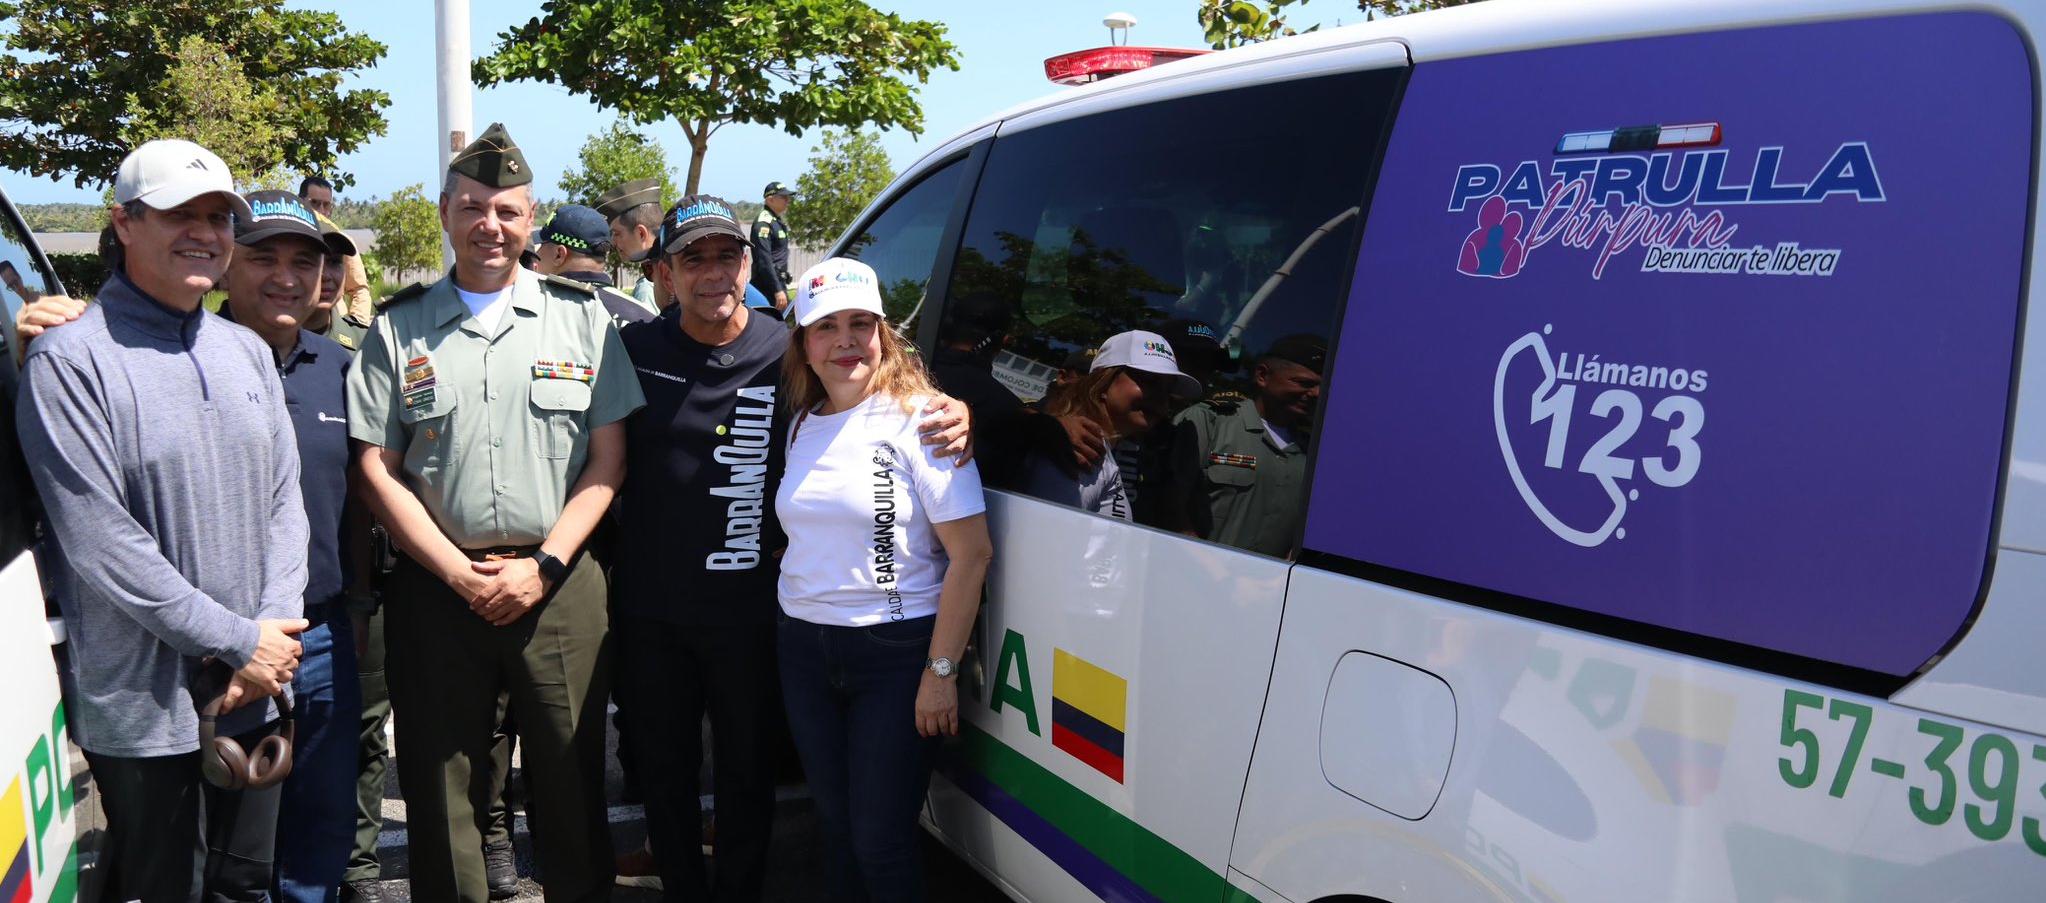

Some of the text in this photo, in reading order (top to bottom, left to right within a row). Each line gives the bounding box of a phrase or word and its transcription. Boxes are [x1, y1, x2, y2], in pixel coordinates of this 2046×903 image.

[1449, 142, 1887, 212] PATRULLA
[1645, 245, 1837, 272] Denunciar te libera
[1556, 352, 1709, 392] Llámanos
[1530, 383, 1705, 488] 123
[873, 468, 896, 584] BARRANQUILLA
